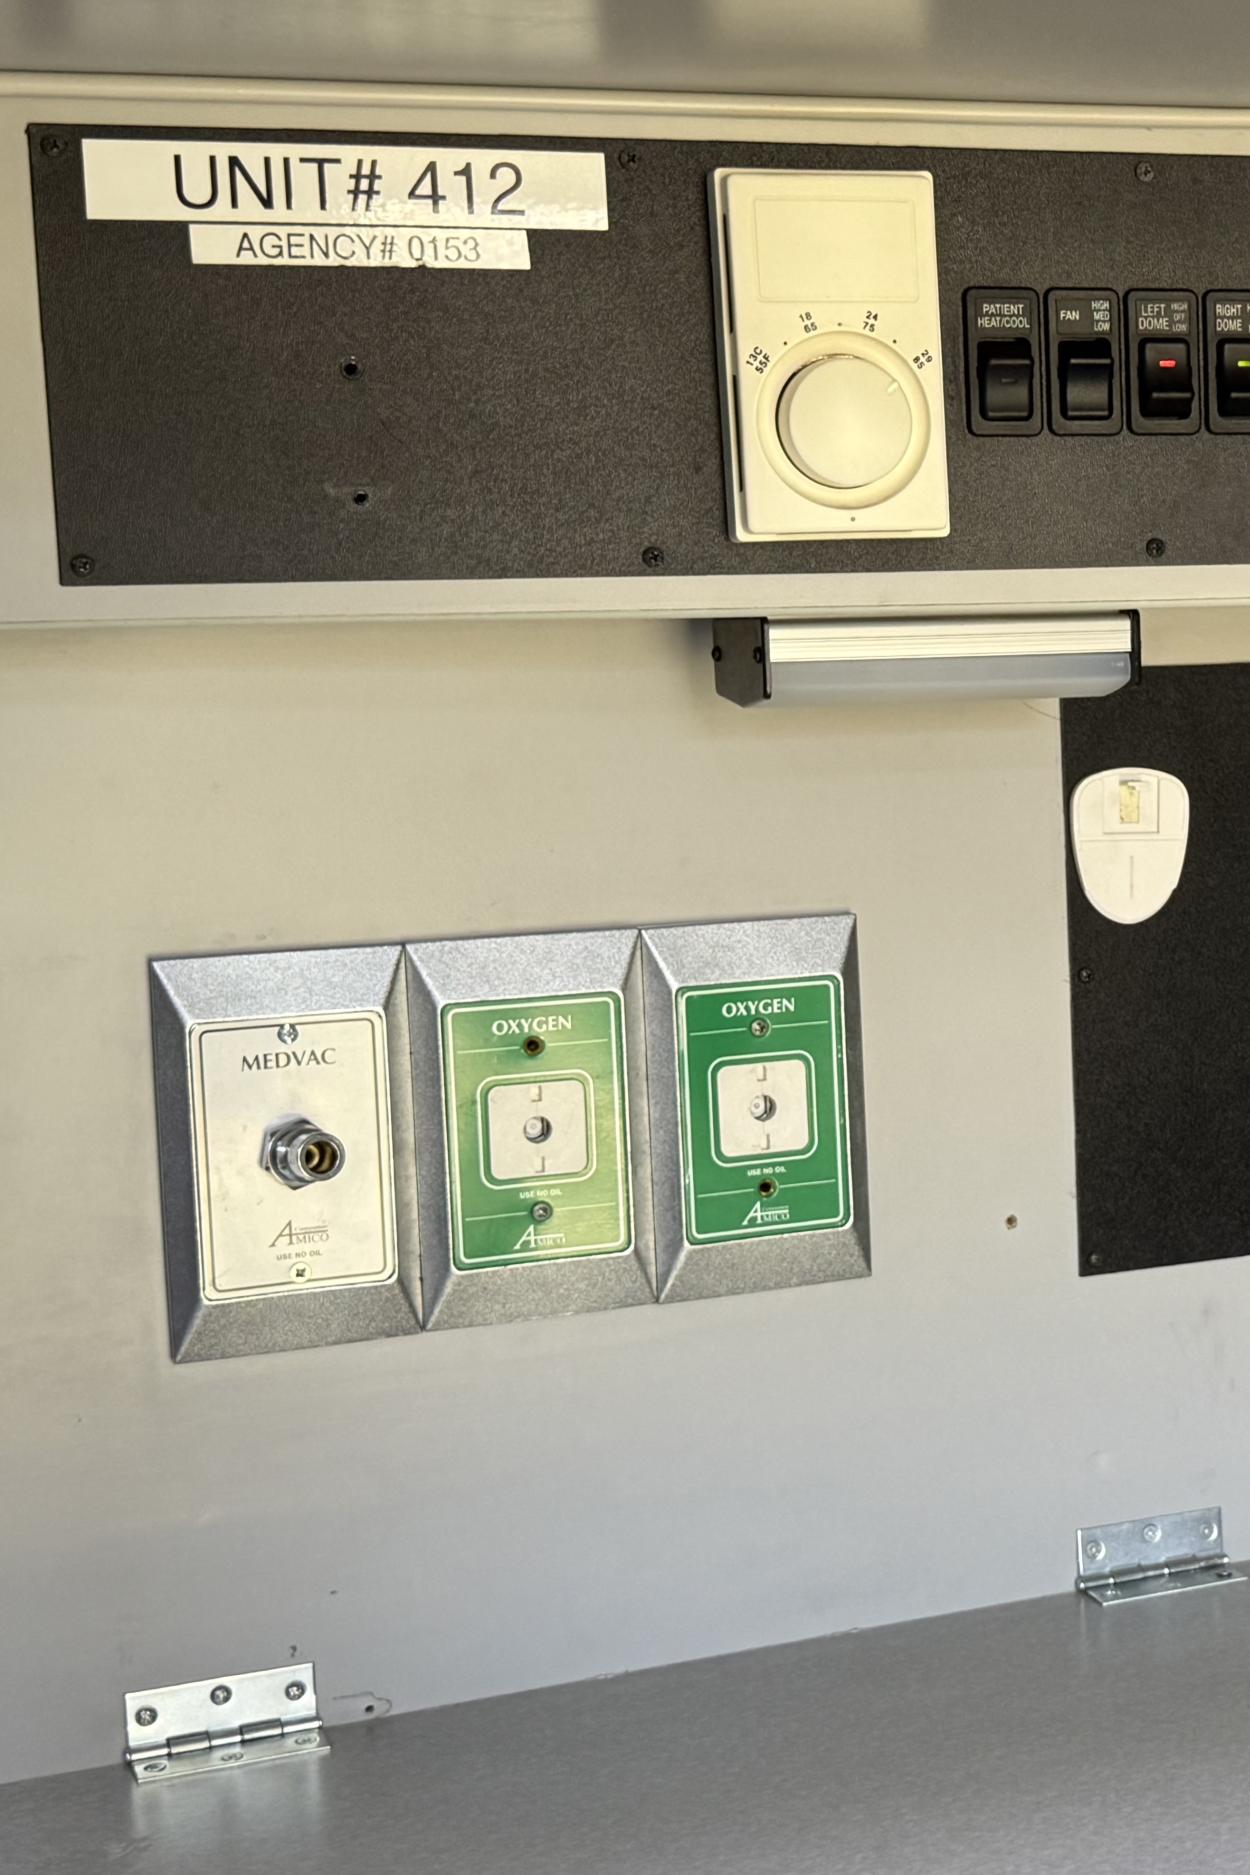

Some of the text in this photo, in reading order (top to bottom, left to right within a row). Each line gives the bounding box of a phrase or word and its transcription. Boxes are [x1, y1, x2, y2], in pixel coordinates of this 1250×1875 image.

[172, 153, 527, 216] UNIT# 412
[235, 232, 482, 262] AGENCY# 0153
[982, 303, 1025, 315] PATIENT
[1091, 300, 1110, 310] HIGH
[1141, 303, 1166, 316] LEFT
[1170, 302, 1188, 311] HIGH
[1215, 304, 1242, 316] RIGHT
[798, 311, 812, 323] 18
[865, 310, 879, 322] 24
[1060, 310, 1080, 320] FAN
[1093, 311, 1110, 321] MED
[1173, 312, 1186, 321] OFF
[803, 322, 818, 333] 65
[862, 321, 875, 333] 75
[977, 316, 1031, 328] HEAT/COOL
[1093, 321, 1111, 331] LOW
[1138, 317, 1170, 330] DOME
[1172, 323, 1187, 332] LOW
[1215, 319, 1243, 331] DOME
[745, 345, 763, 367] 13C
[920, 349, 933, 364] 29
[754, 353, 772, 374] 55F
[912, 356, 925, 369] 85
[721, 997, 796, 1018] OXYGEN
[491, 1015, 573, 1036] OXYGEN
[240, 1048, 337, 1072] MEDVAC
